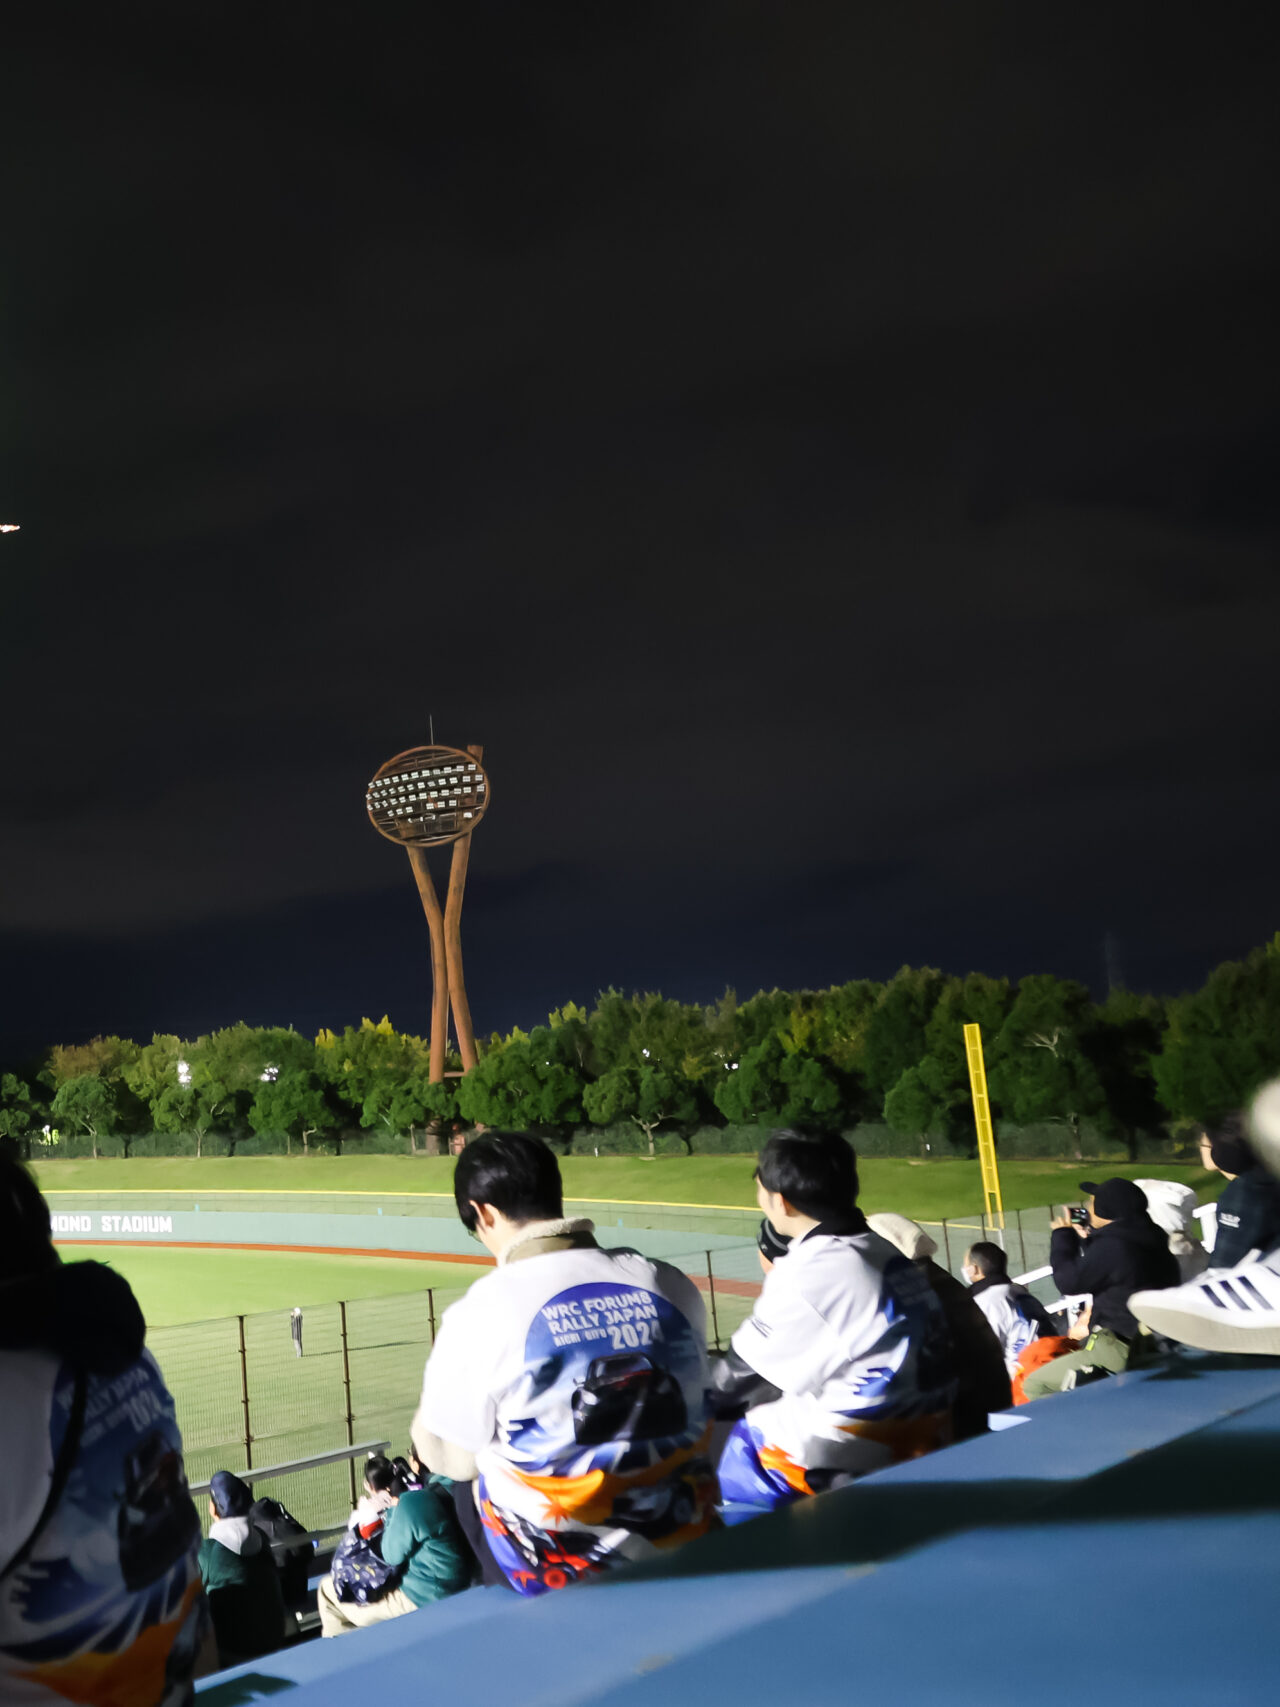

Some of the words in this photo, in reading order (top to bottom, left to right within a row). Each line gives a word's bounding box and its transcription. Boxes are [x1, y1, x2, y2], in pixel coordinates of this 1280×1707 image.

[101, 1215, 173, 1233] STADIUM
[541, 1301, 582, 1321] WRC
[548, 1313, 600, 1335] RALLY
[604, 1304, 659, 1325] JAPAN
[607, 1319, 665, 1350] 2024
